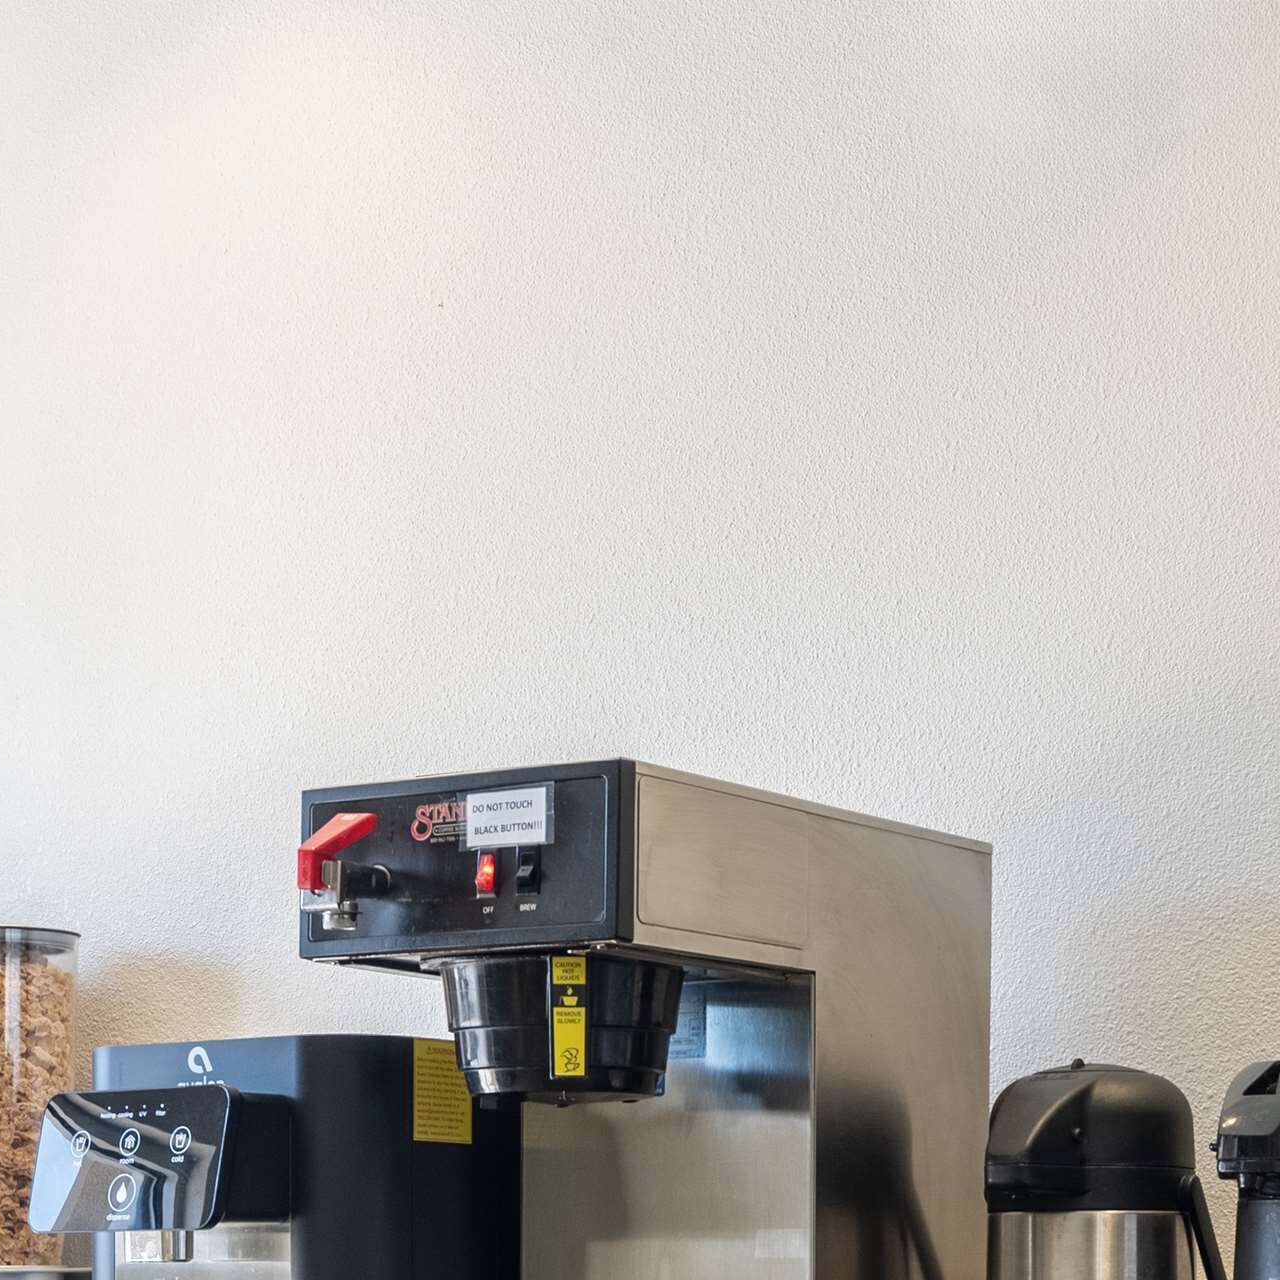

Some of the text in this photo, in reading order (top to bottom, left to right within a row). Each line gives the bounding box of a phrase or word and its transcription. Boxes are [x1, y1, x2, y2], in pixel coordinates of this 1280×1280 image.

[472, 800, 533, 814] DO NOT TOUCH
[474, 825, 499, 835] BLACK
[500, 820, 543, 832] BUTTON!!!
[482, 905, 494, 915] OFF
[519, 903, 537, 912] BREW
[554, 961, 582, 969] CAUTION
[170, 1155, 184, 1163] cold
